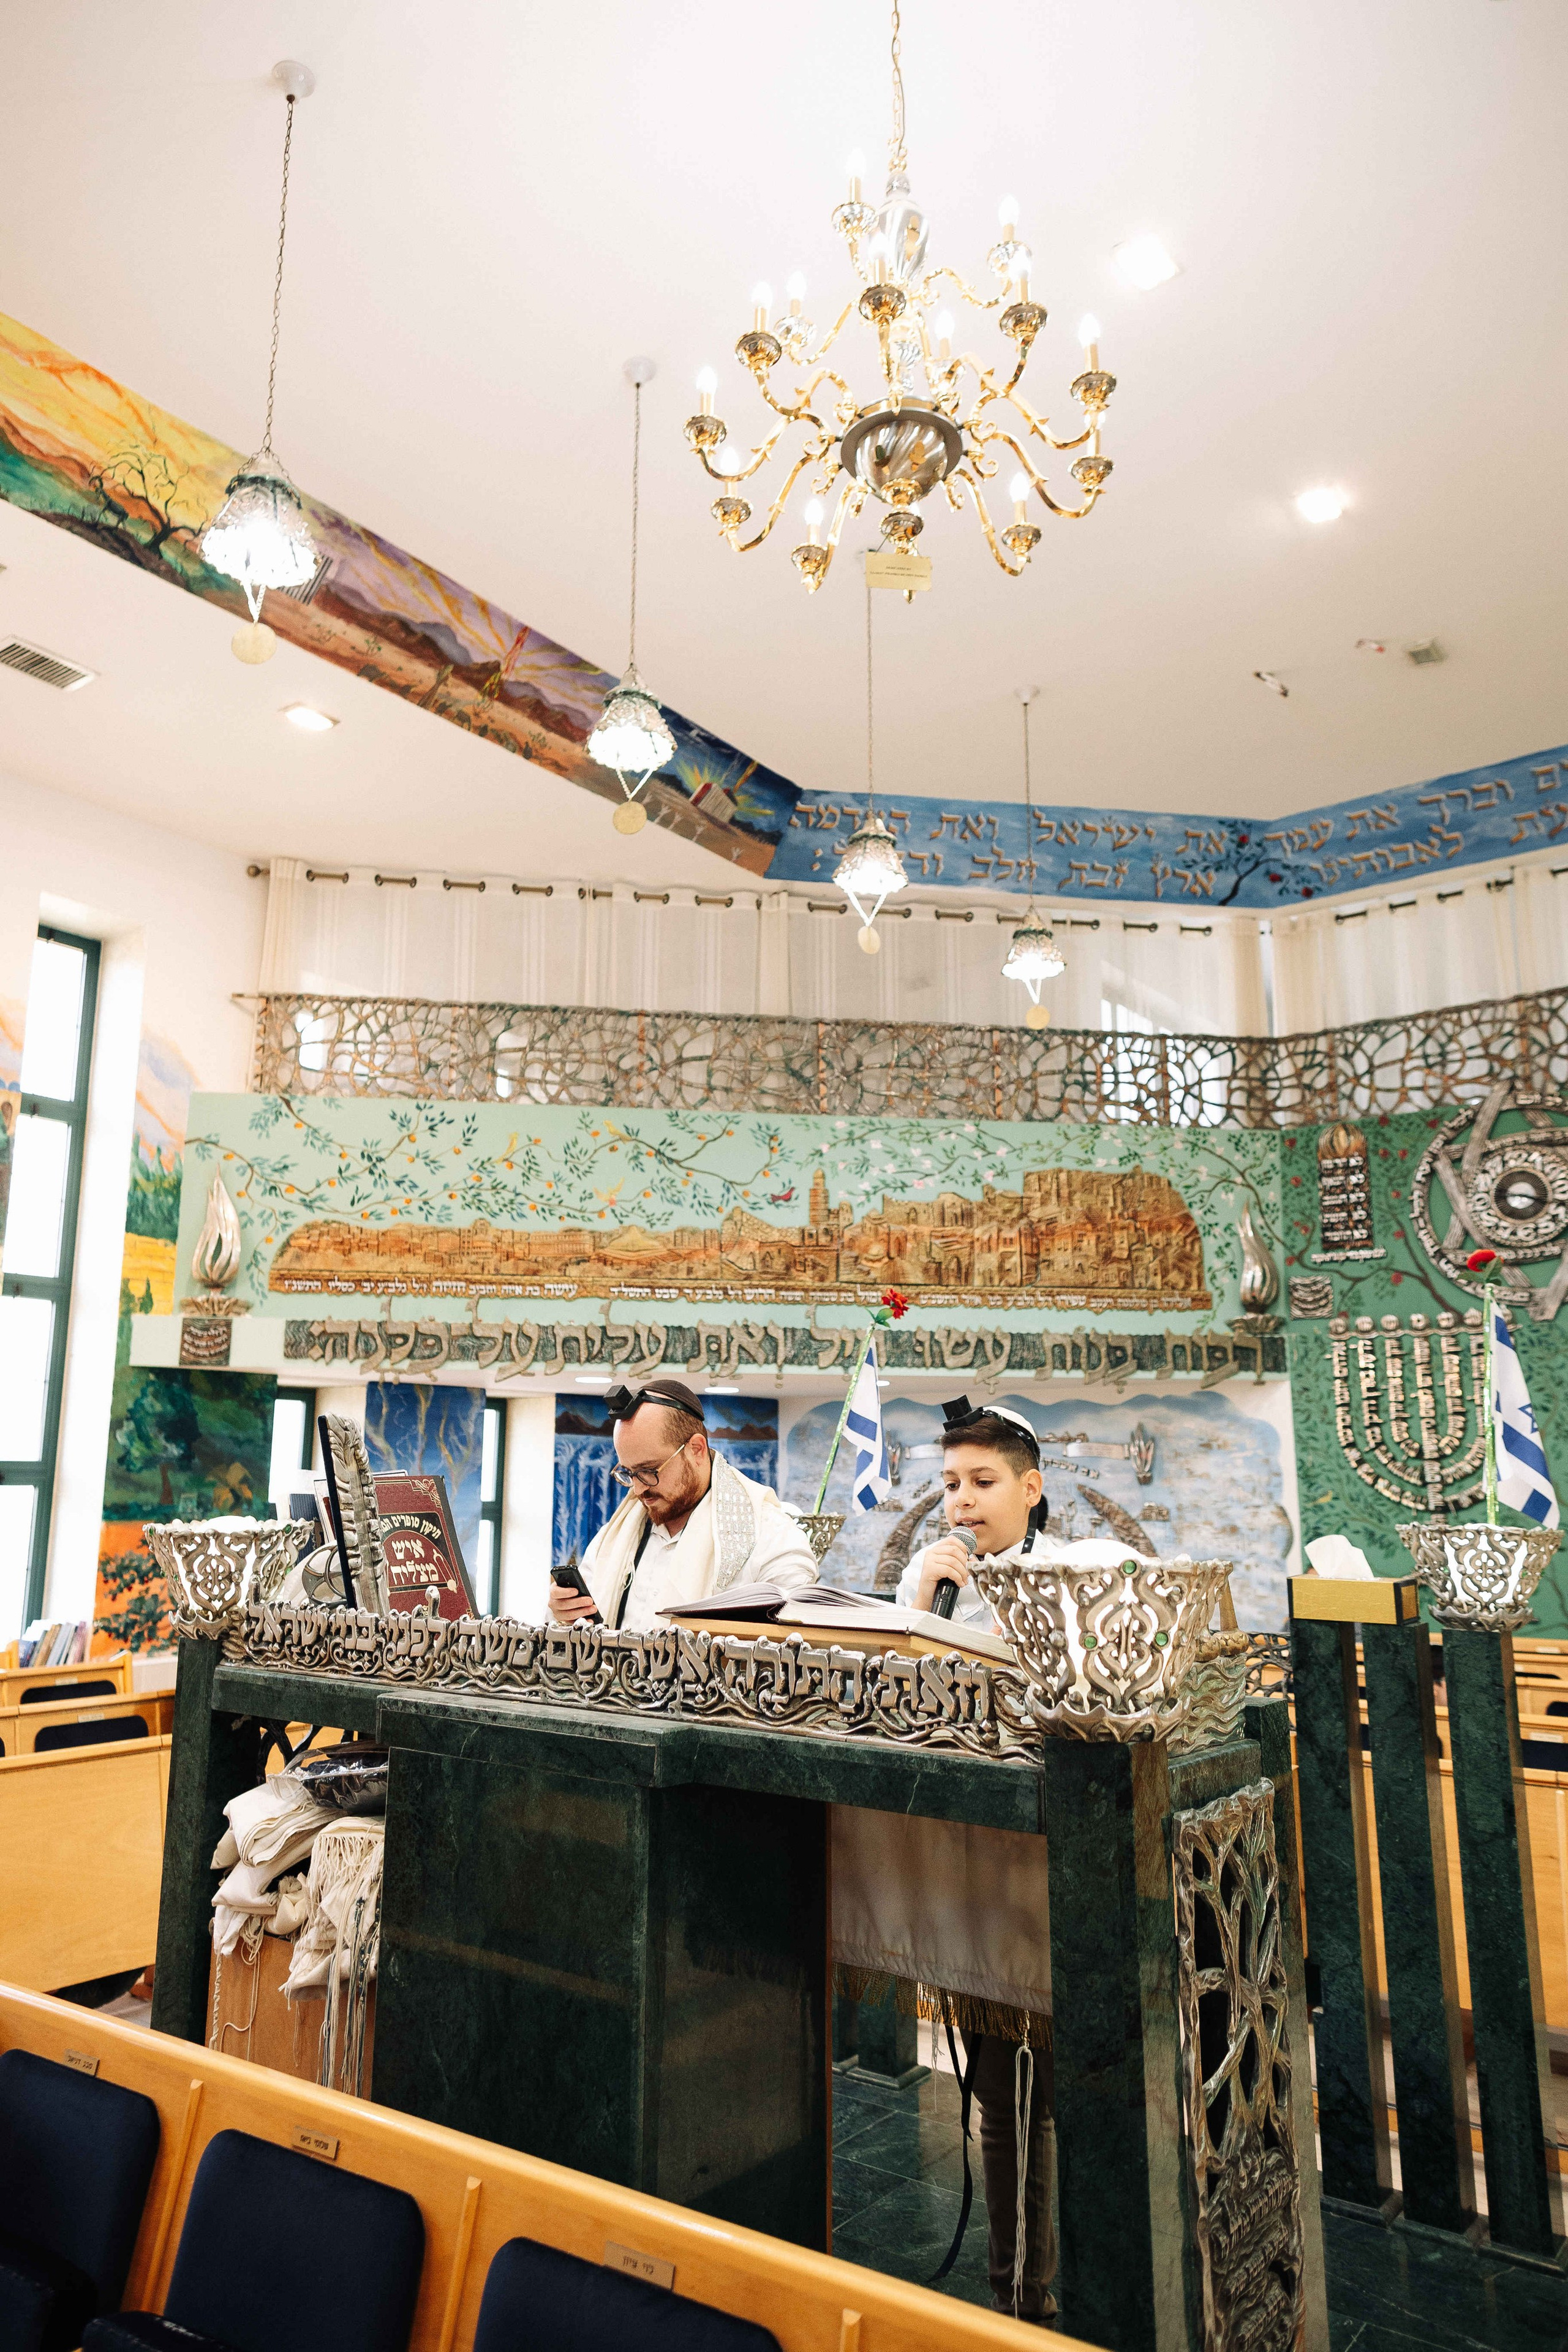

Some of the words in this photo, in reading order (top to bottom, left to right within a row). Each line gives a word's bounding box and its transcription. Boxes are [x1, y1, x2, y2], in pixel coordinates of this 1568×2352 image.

[1419, 779, 1514, 824] וברך
[930, 812, 998, 843] ואת
[1033, 808, 1156, 850] ישראל
[1347, 804, 1399, 839] את
[1176, 829, 1227, 854] את
[1265, 820, 1334, 858] עמך
[970, 842, 1039, 883] חלב
[1058, 858, 1128, 891] זבת
[1150, 856, 1216, 898] ארץ
[328, 1275, 356, 1292] כסליו
[391, 1515, 420, 1528] סופרים
[420, 1520, 441, 1539] תיקון
[391, 1539, 425, 1559] איש
[390, 1559, 439, 1585] מצליח
[458, 1614, 535, 1667] משה
[880, 1651, 992, 1724] וזאת
